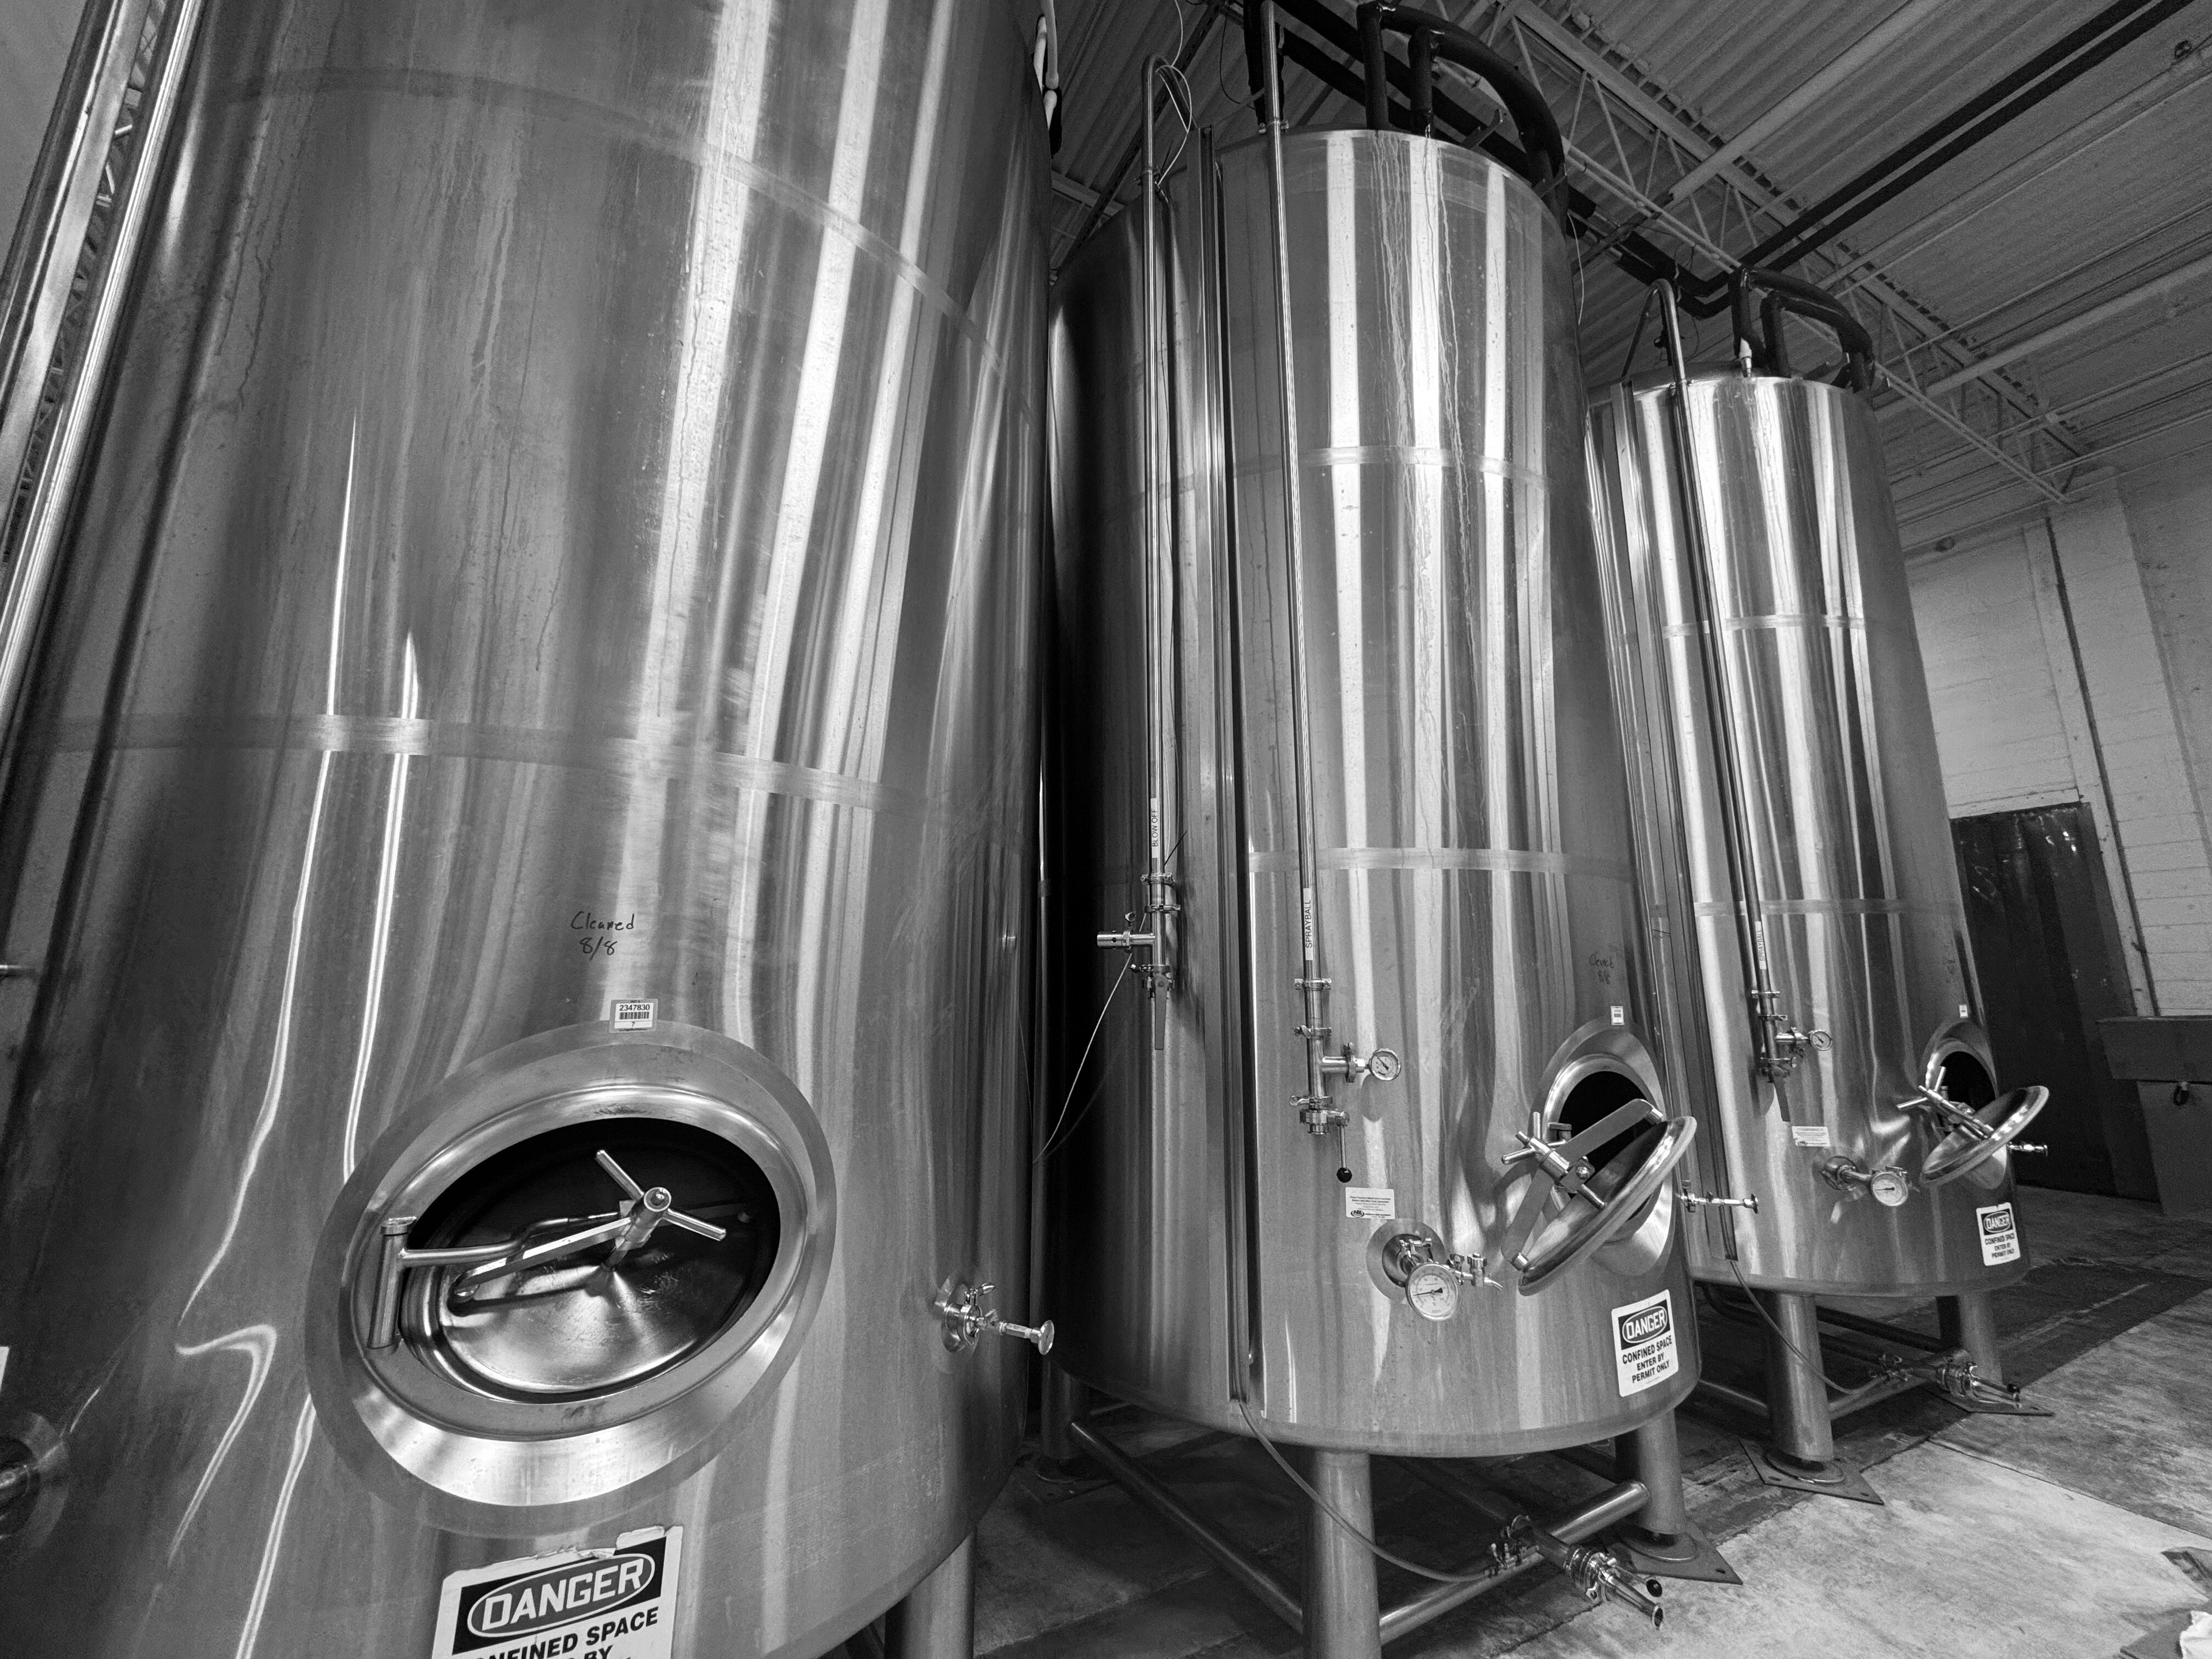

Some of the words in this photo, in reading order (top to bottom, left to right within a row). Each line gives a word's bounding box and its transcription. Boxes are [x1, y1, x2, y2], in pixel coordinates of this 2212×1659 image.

[570, 911, 635, 931] Cleaned
[1304, 900, 1313, 948] SPRAYBALL
[579, 936, 618, 961] 8/8
[1626, 1309, 1666, 1340] DANGER
[1622, 1344, 1656, 1365] CONFINED
[1656, 1335, 1672, 1352] SPACE
[1637, 1357, 1657, 1371] ENTER
[1657, 1351, 1664, 1362] BY
[1632, 1367, 1655, 1383] PERMIT
[1656, 1359, 1669, 1373] ONLY
[482, 1558, 645, 1631] DANGER
[586, 1607, 659, 1646] SPACE
